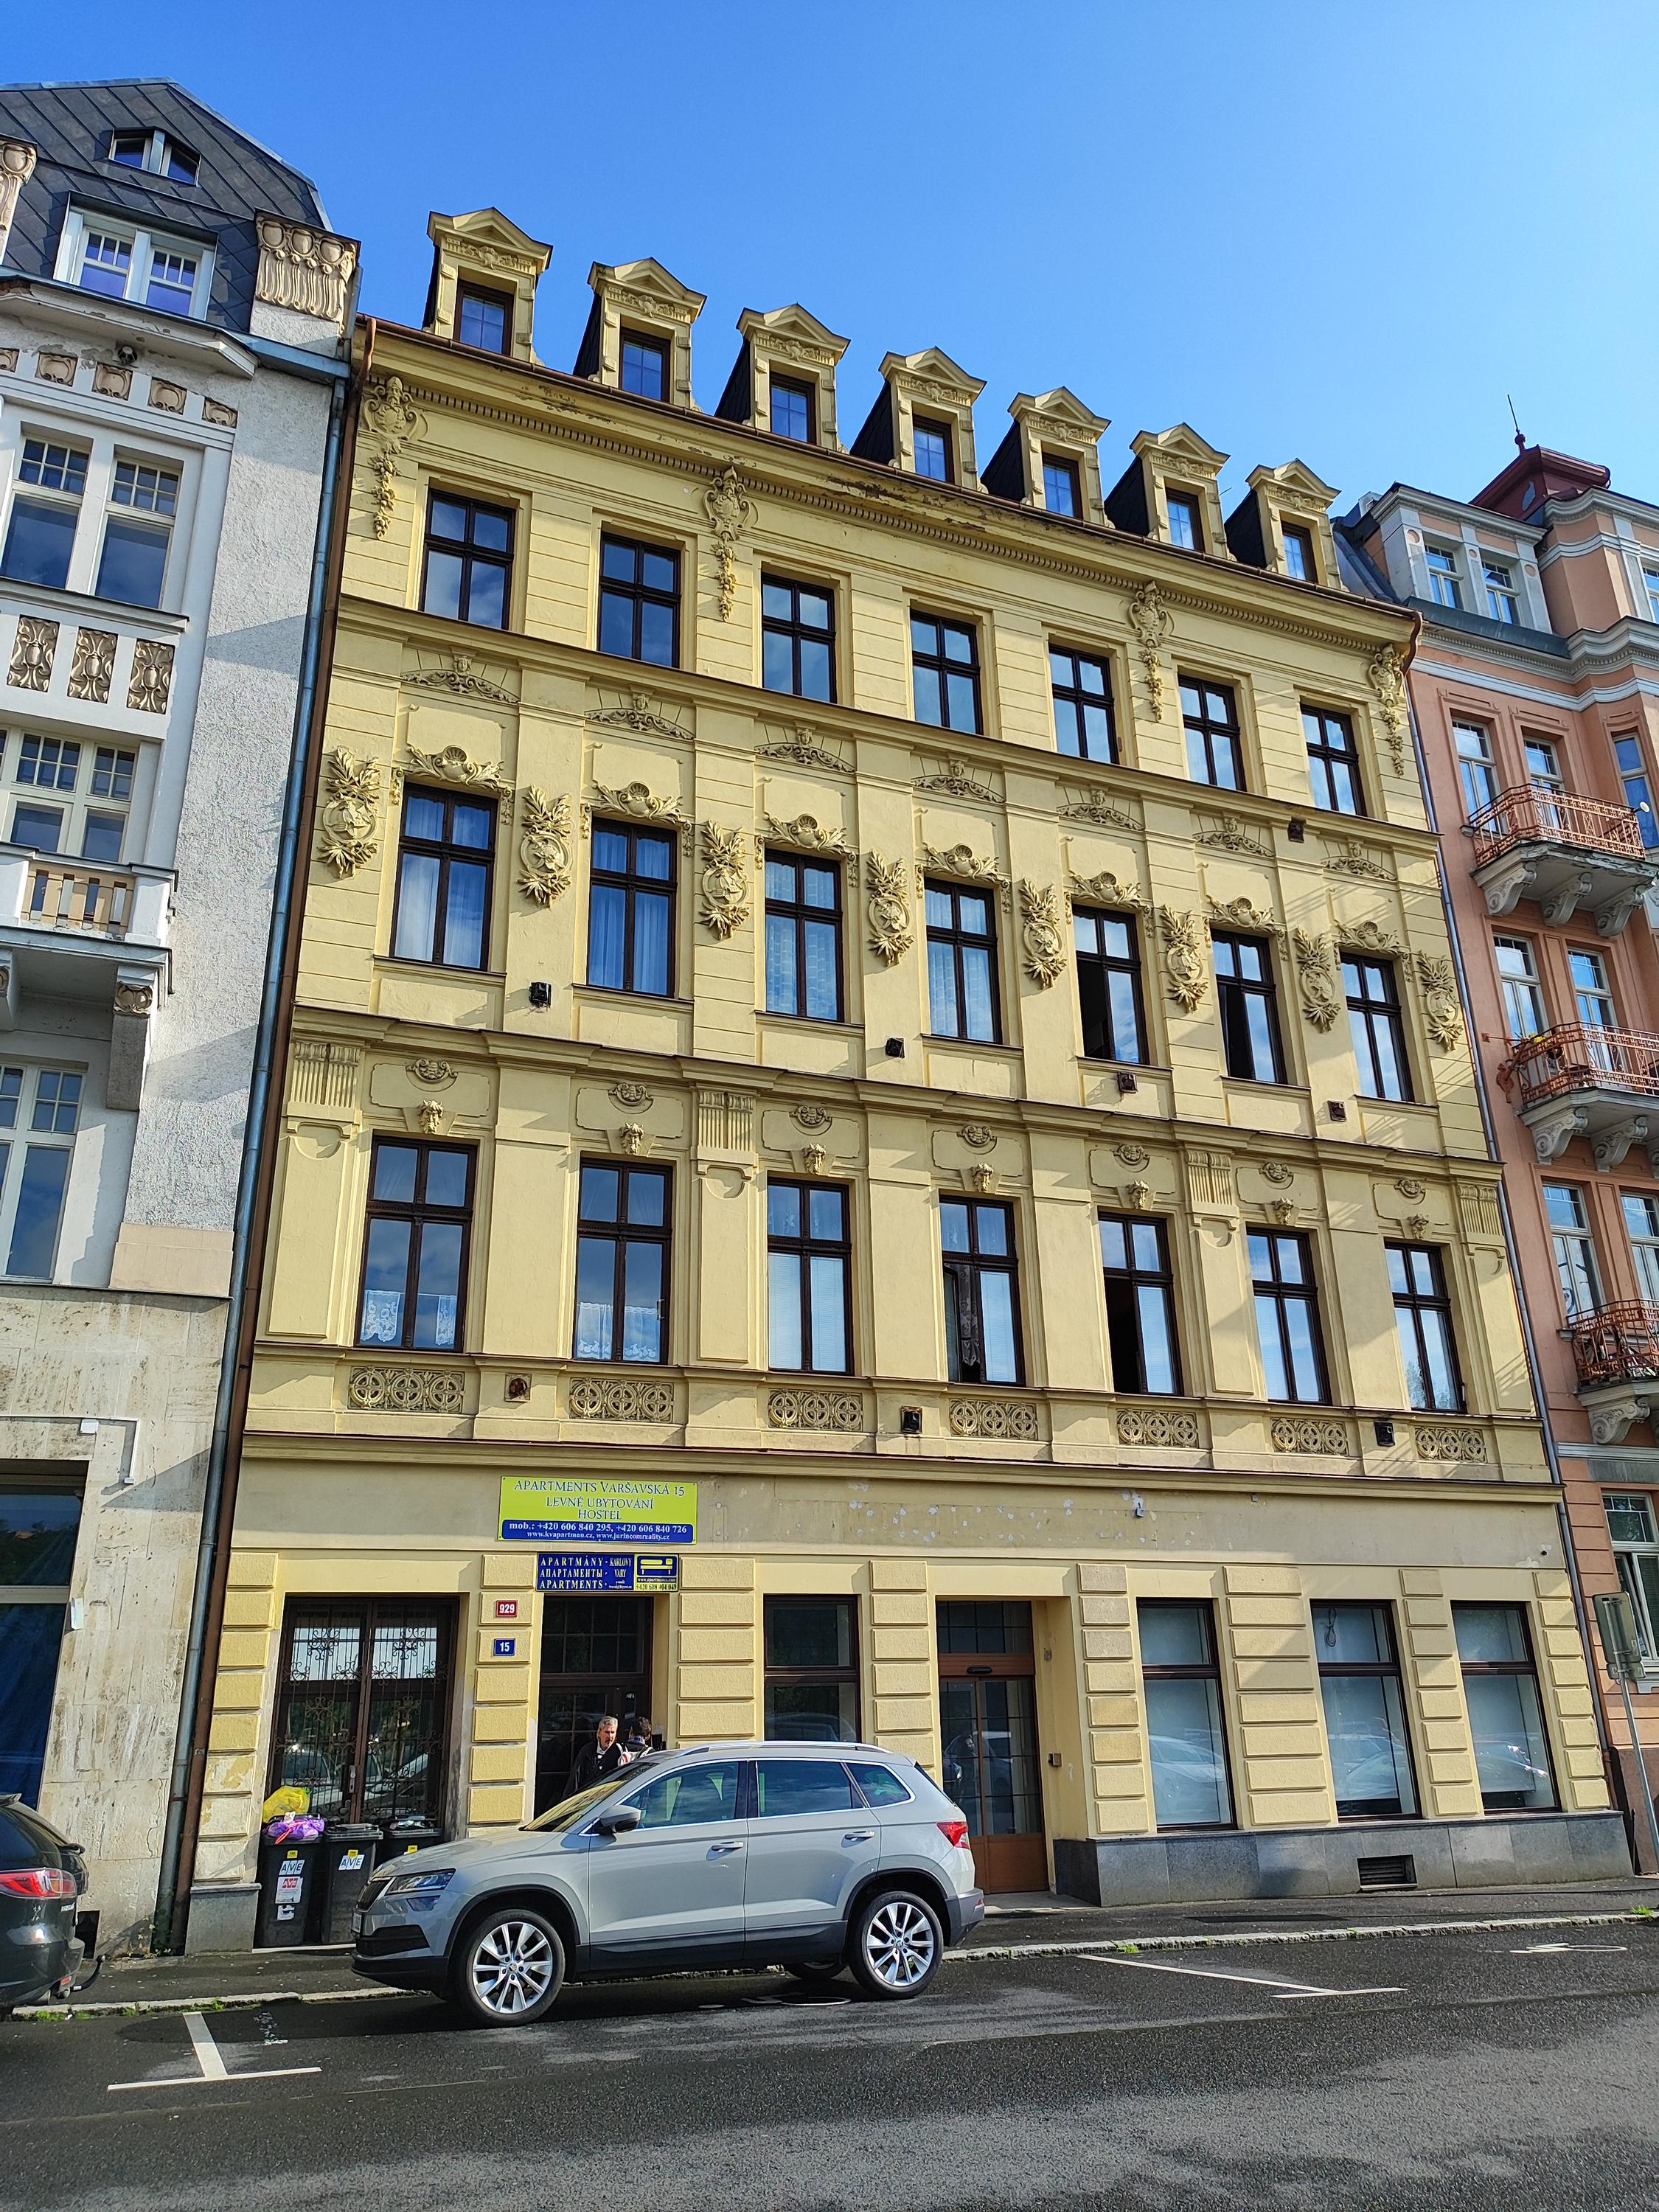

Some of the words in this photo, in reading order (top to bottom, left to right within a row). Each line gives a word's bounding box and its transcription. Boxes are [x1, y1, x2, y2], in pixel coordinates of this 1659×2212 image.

[514, 1480, 597, 1492] APARTMENTS
[600, 1481, 669, 1495] VARŠAVSKÁ
[674, 1486, 685, 1496] 15
[546, 1496, 583, 1507] LEVNÉ
[588, 1498, 654, 1509] UBYTOVÁNÍ
[578, 1509, 623, 1520] HOSTEL
[537, 1522, 558, 1530] +420
[560, 1523, 576, 1531] 606
[578, 1523, 594, 1531] 840
[596, 1523, 613, 1532] 295,
[616, 1524, 636, 1532] +420
[639, 1524, 653, 1533] 606
[655, 1525, 670, 1533] 840
[672, 1525, 687, 1533] 726
[540, 1556, 604, 1567] APARTMÁNY
[609, 1557, 632, 1567] KARLOVY
[540, 1568, 602, 1578] АПАРТАМЕНТЫ
[613, 1569, 627, 1578] VARY
[539, 1579, 603, 1589] APARTMENTS
[499, 1604, 515, 1614] 929
[500, 1642, 510, 1652] 15
[341, 1857, 364, 1866] AVE
[281, 1863, 303, 1871] AVE
[282, 1879, 298, 1888] AVE
